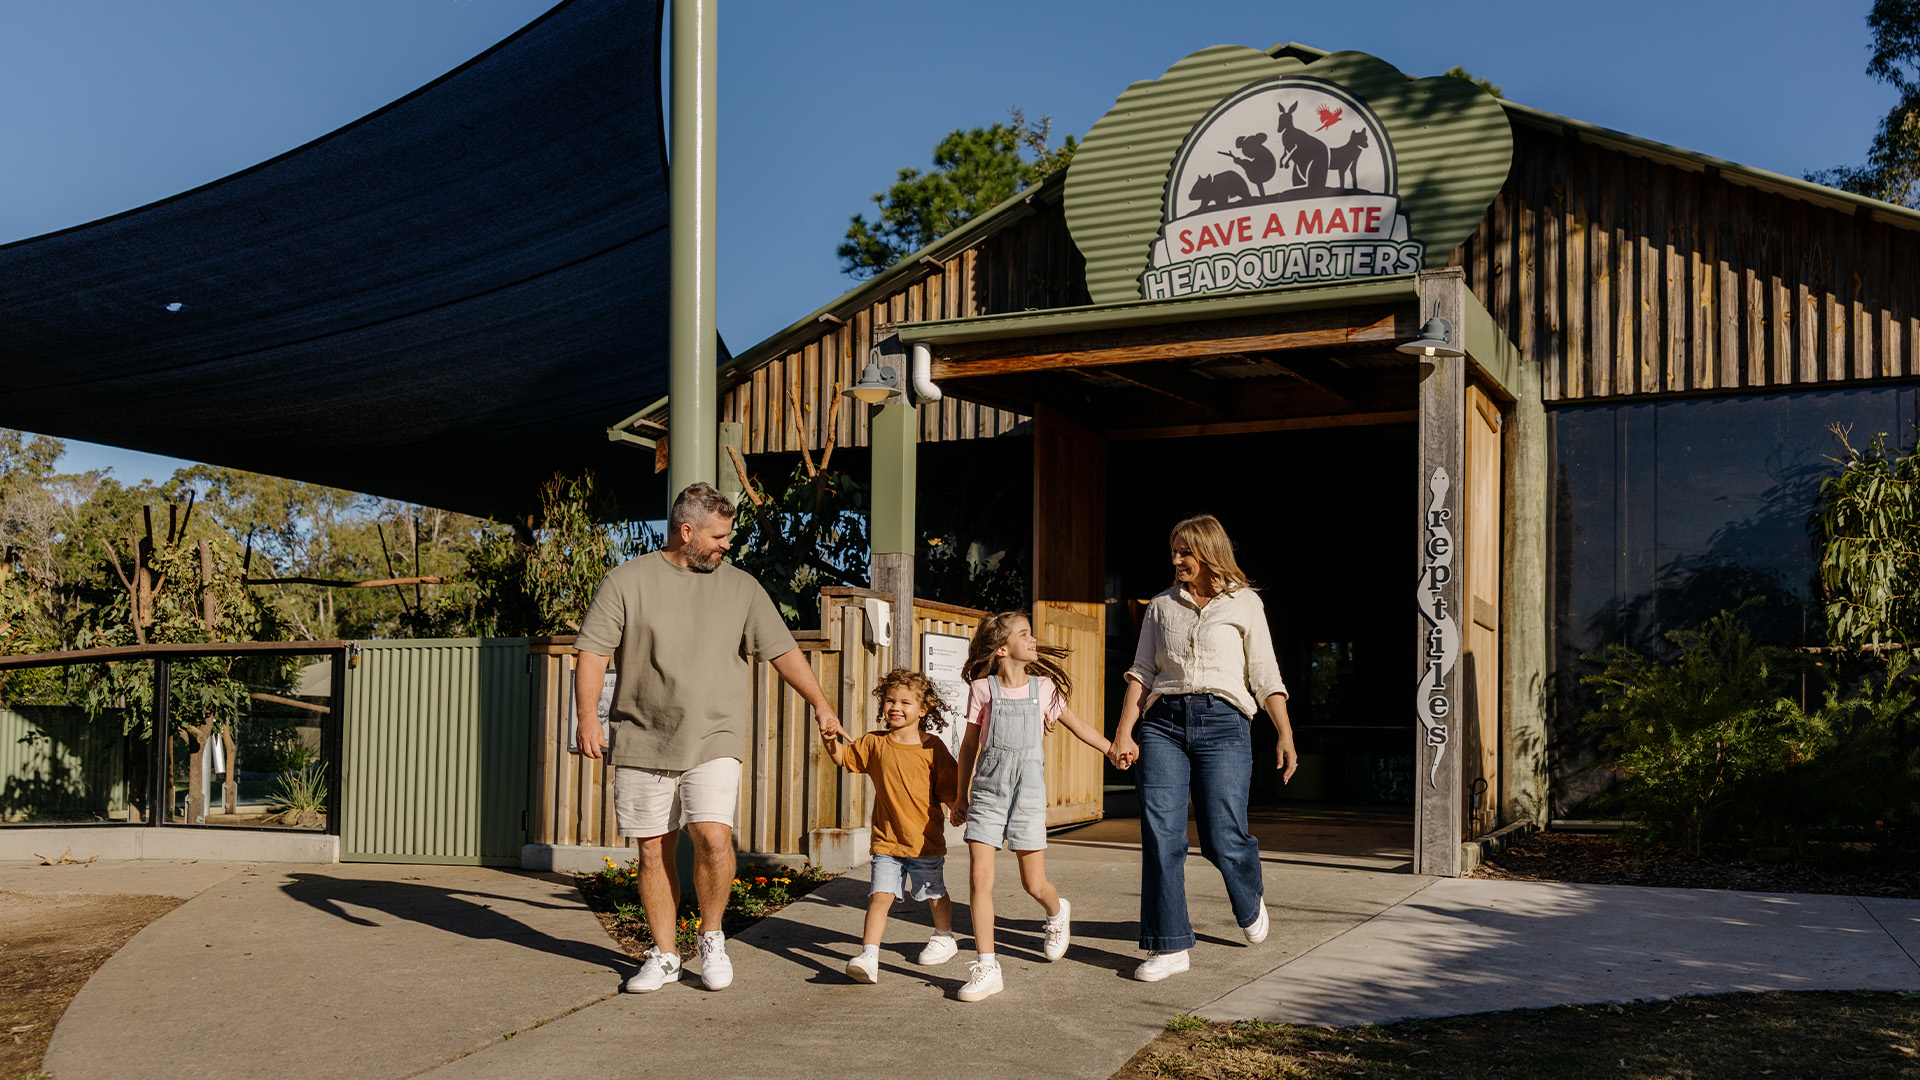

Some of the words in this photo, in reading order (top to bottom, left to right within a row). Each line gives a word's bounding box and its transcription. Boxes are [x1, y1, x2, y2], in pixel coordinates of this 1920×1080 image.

[1179, 216, 1253, 255] SAVE
[1262, 213, 1286, 239] A
[1295, 206, 1382, 236] MATE
[1147, 246, 1420, 300] HEADQUARTERS
[1428, 509, 1450, 744] reptiles
